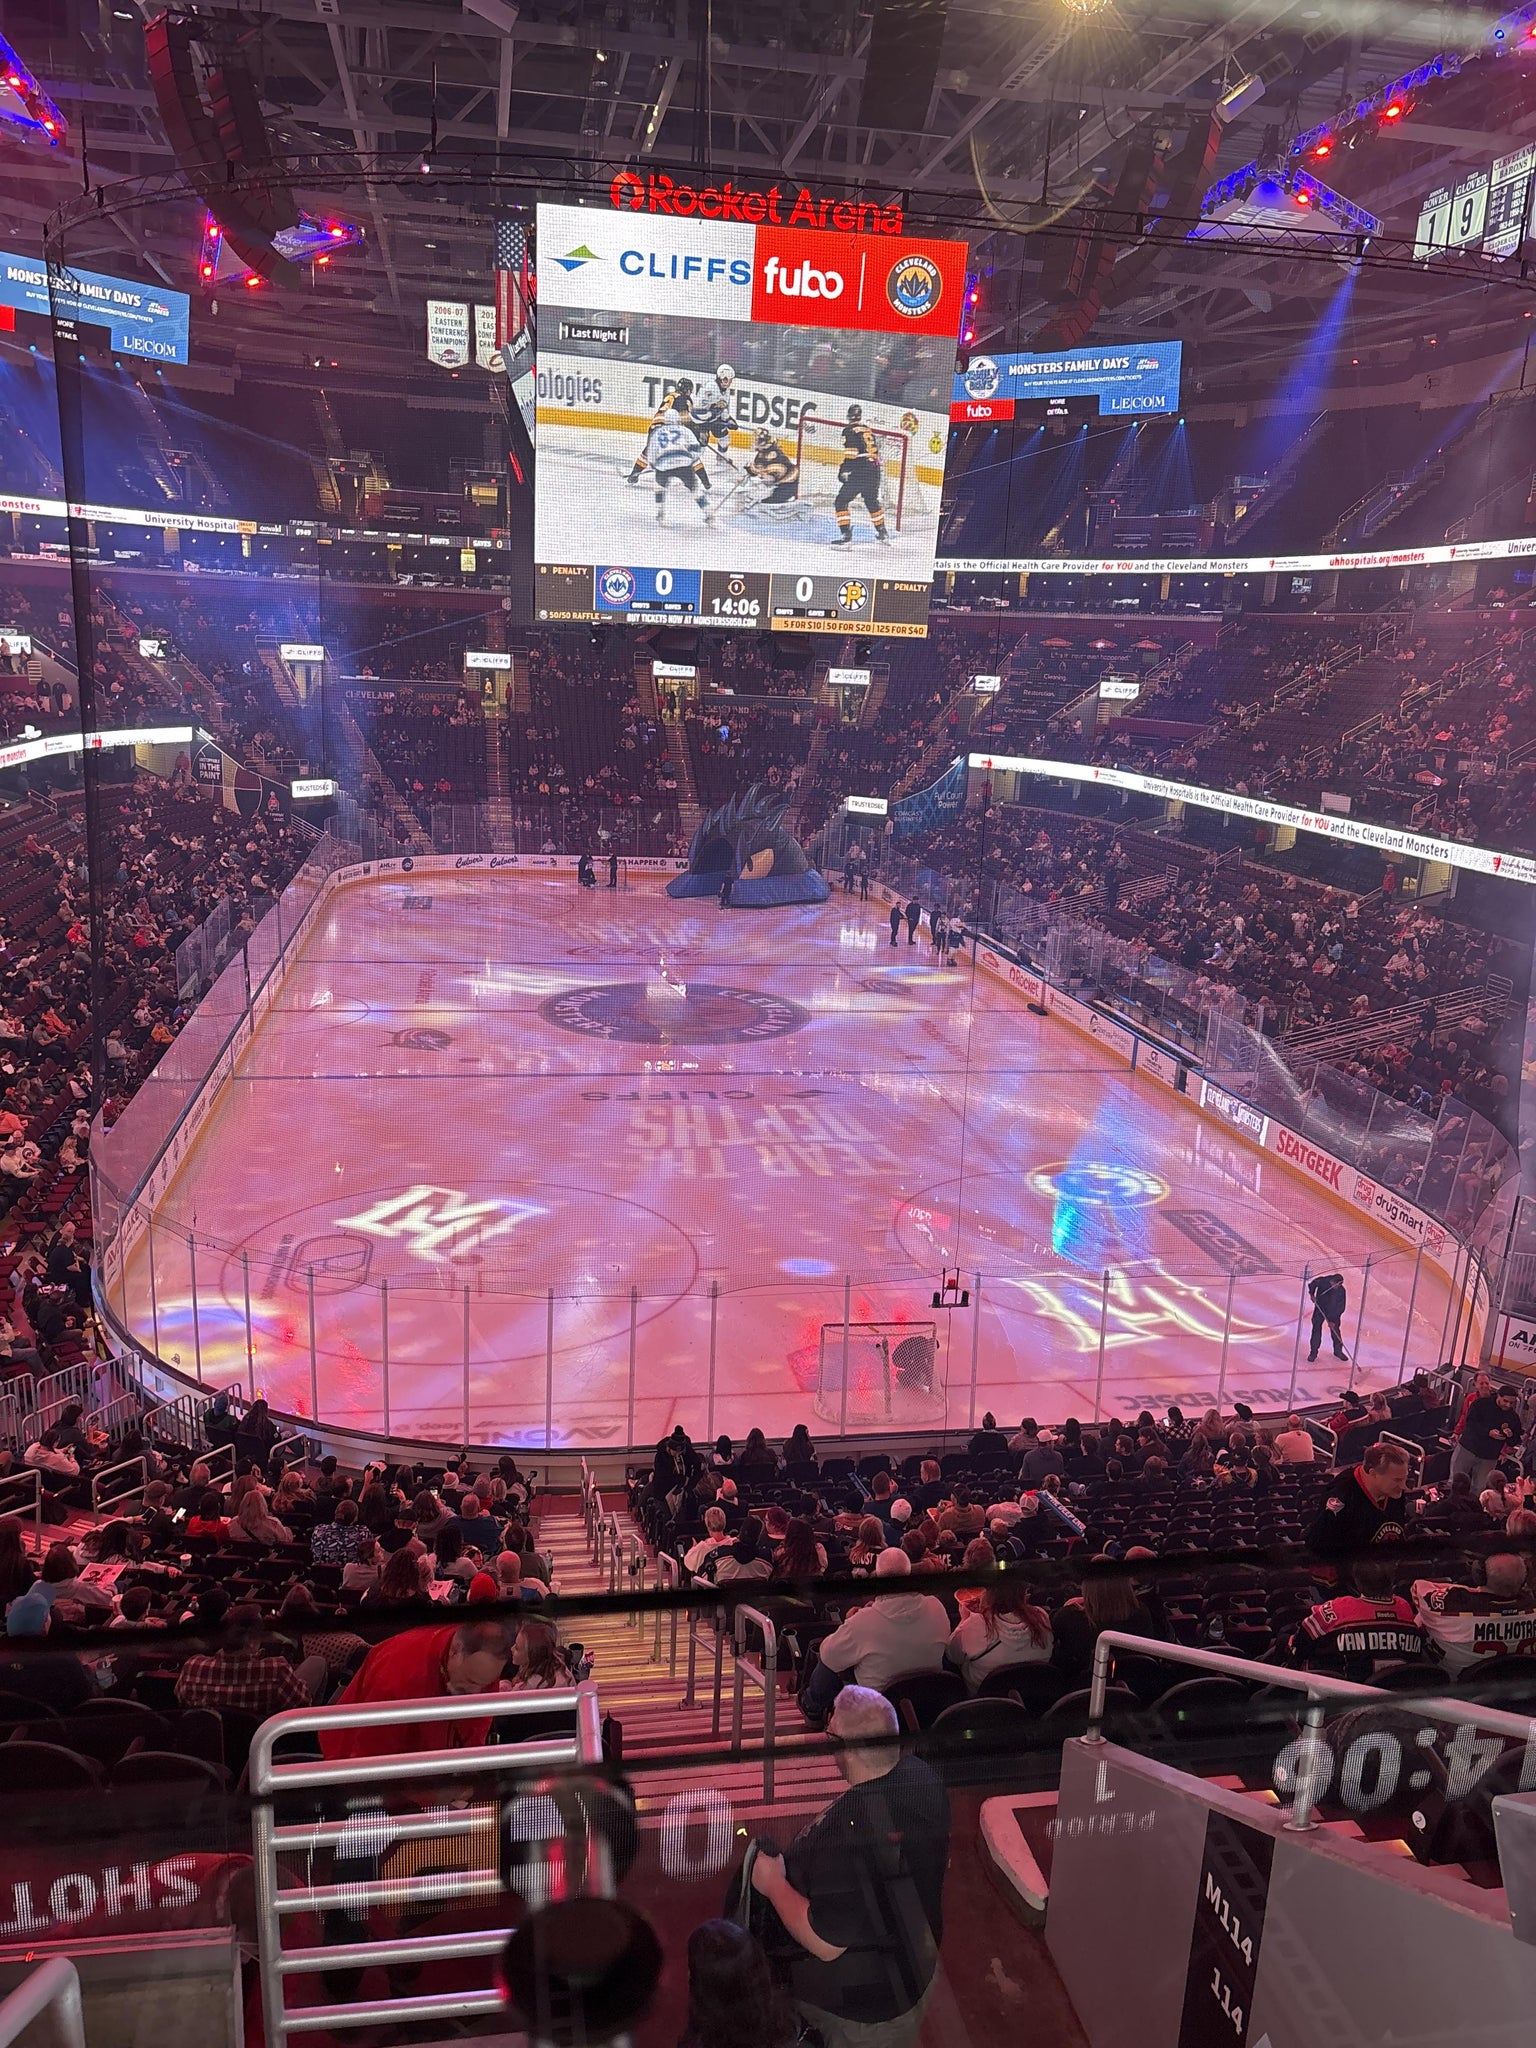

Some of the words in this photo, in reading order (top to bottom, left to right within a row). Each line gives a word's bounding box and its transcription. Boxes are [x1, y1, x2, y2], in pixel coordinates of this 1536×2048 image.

[1500, 159, 1528, 178] BARONS
[1456, 174, 1488, 196] GLOVER
[650, 174, 782, 223] Rocket
[789, 188, 904, 234] Arena
[1422, 192, 1449, 210] BOWER
[1461, 198, 1474, 236] 9
[1428, 213, 1436, 250] 1
[620, 250, 751, 285] CLIFFS
[895, 258, 936, 277] CLEVELAND
[7, 266, 71, 292] MONSTERS
[114, 291, 142, 307] DAYS
[764, 256, 844, 300] fubo
[434, 306, 463, 315] 2006-07
[893, 298, 932, 316] MONSTERS
[430, 327, 468, 336] CONFERENCE
[436, 318, 463, 327] EASTERN
[432, 336, 466, 346] CHAMPIONS
[572, 329, 591, 339] Last
[592, 330, 617, 342] Night
[1009, 361, 1063, 376] MONSTERS
[1064, 359, 1101, 372] FAMILY
[1103, 357, 1130, 370] DAYS
[538, 367, 602, 407] ologies
[967, 405, 992, 418] fubo
[144, 514, 194, 529] University
[552, 566, 587, 575] PENALTY
[953, 561, 961, 570] is
[963, 561, 977, 570] the
[980, 561, 1010, 570] Official
[1012, 561, 1039, 570] Health
[1041, 562, 1060, 570] Care
[1062, 561, 1099, 570] Provider
[1102, 561, 1114, 570] for
[1135, 561, 1150, 570] and
[1152, 561, 1165, 570] the
[1167, 561, 1207, 570] Cleveland
[1210, 561, 1248, 570] Monsters
[655, 569, 673, 595] 0
[796, 576, 813, 602] 0
[894, 583, 927, 593] PENALTY
[847, 585, 862, 605] P
[550, 611, 571, 619] 50/50
[712, 597, 760, 616] 14:06
[626, 614, 640, 623] BUY
[641, 614, 668, 624] TICKETS
[668, 615, 682, 624] NOW
[684, 616, 693, 624] AT
[808, 621, 822, 630] $10
[826, 622, 837, 630] 50
[838, 623, 854, 631] FOR
[856, 624, 870, 632] $20
[877, 625, 890, 633] 125
[892, 625, 907, 634] FOR
[908, 626, 924, 635] $40
[200, 771, 221, 780] PAINT
[852, 801, 884, 810] TRUSTEDSEC
[1144, 779, 1168, 795] University
[1170, 785, 1193, 800] Hospitals
[1194, 791, 1200, 800] is
[1200, 793, 1210, 803] the
[1211, 794, 1232, 808] Official
[1233, 799, 1253, 812] Health
[1255, 804, 1268, 816] Care
[1270, 808, 1300, 823] Provider
[1301, 814, 1312, 826] for
[1314, 817, 1329, 830] YOU
[1331, 822, 1346, 834] and
[1347, 824, 1360, 838] the
[1362, 827, 1403, 848] Cleveland
[1406, 837, 1449, 858] Monsters
[456, 856, 484, 868] Culver's
[490, 856, 518, 868] Culver's
[1016, 970, 1039, 997] Rocket
[1276, 1129, 1344, 1191] SEATGEEK
[1358, 1180, 1372, 1196] drug
[1356, 1191, 1373, 1205] mart
[1391, 1196, 1412, 1212] DISCOUNT
[1376, 1194, 1398, 1220] drug
[1399, 1211, 1424, 1234] mart
[1427, 1224, 1443, 1241] drug
[1116, 1386, 1320, 1410] TRUSTEDSEC
[1337, 1632, 1365, 1652] VAN
[1369, 1632, 1399, 1650] DER
[1206, 1872, 1254, 1966] M114
[1210, 1967, 1243, 2036] 114
